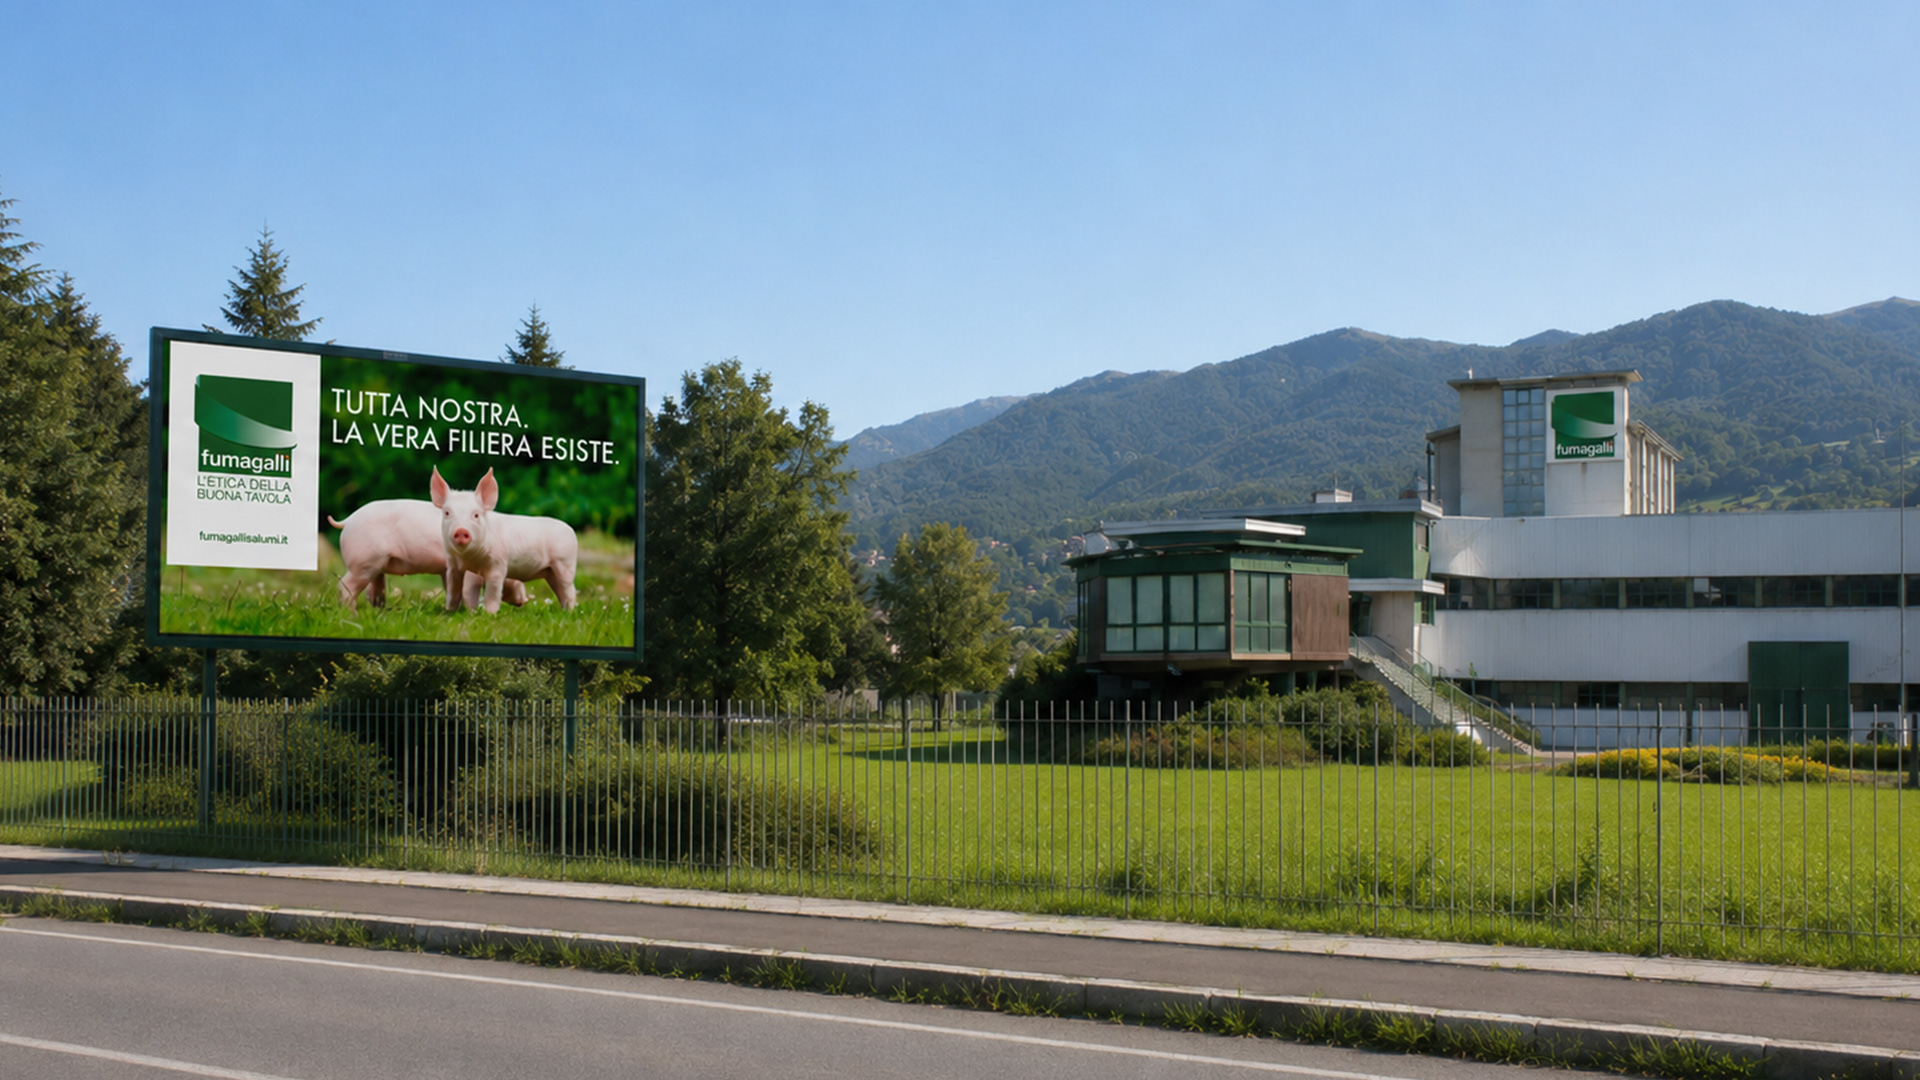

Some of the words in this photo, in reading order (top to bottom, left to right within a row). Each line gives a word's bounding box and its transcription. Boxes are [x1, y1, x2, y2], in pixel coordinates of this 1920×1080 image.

[331, 388, 409, 418] TUTTA
[418, 397, 528, 428] NOSTRA.
[332, 419, 364, 445] LA
[372, 423, 440, 451] VERA
[449, 429, 533, 458] FILIERA
[542, 436, 620, 465] ESISTE.
[1556, 441, 1613, 457] fumagalli
[201, 449, 290, 474] fumagalli
[197, 475, 246, 489] L'ETICA
[249, 478, 291, 492] DELLA
[197, 488, 242, 501] BUONA
[245, 491, 291, 504] TAVOLA
[199, 530, 288, 545] fumagallisalumi.it
